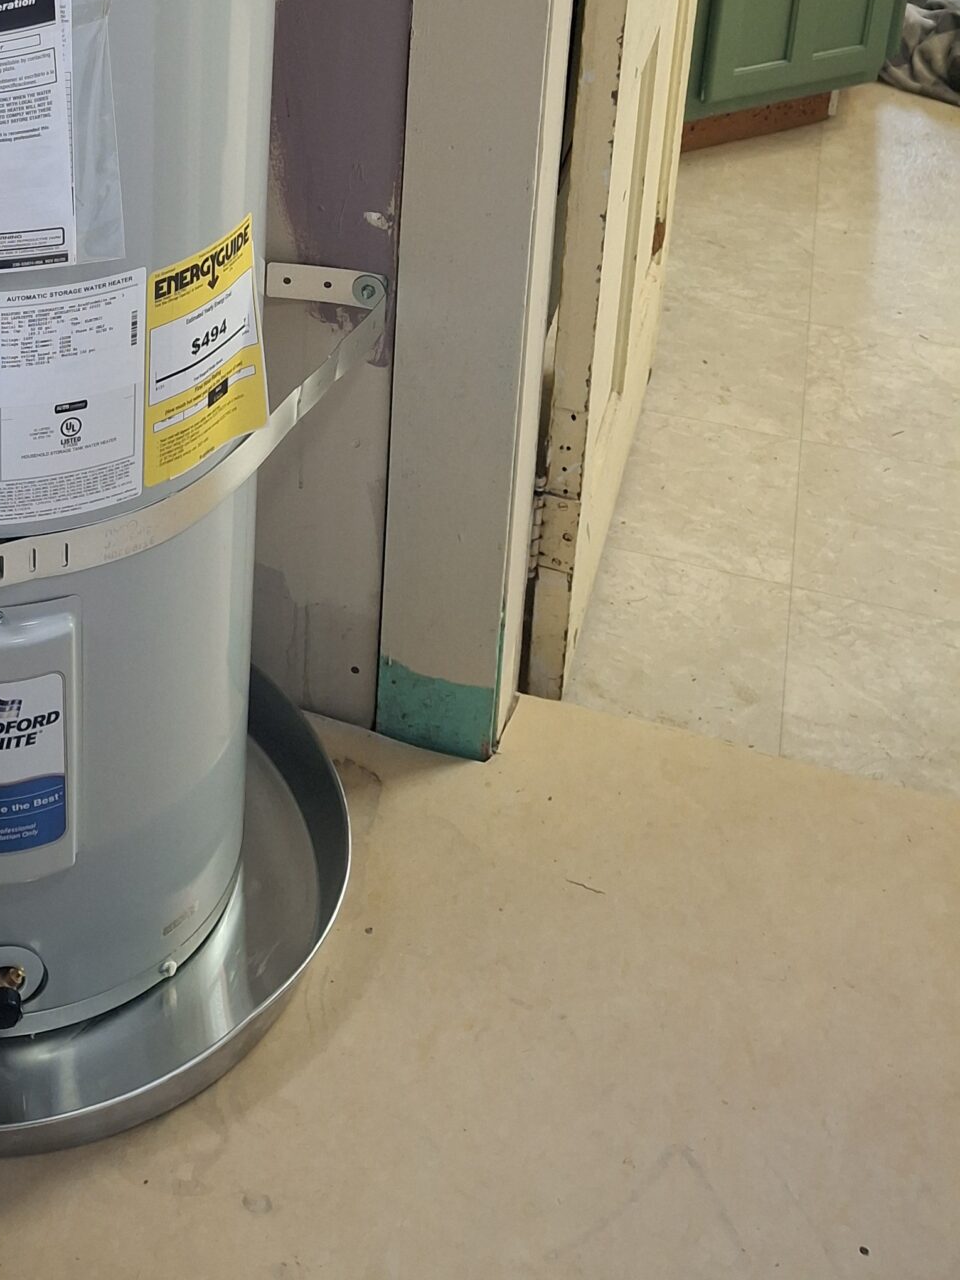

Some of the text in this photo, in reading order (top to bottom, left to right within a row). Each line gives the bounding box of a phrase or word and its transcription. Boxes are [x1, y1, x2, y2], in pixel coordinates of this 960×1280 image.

[154, 223, 250, 300] ENERGYGUIDE
[6, 276, 133, 302] AUTOMATIC STORAGE WATER HEATER
[191, 318, 228, 356] $494
[20, 451, 49, 459] HOUSEHOLD
[100, 437, 117, 445] HEATER
[60, 436, 82, 446] LISTED
[11, 803, 30, 812] the
[21, 828, 39, 838] Only
